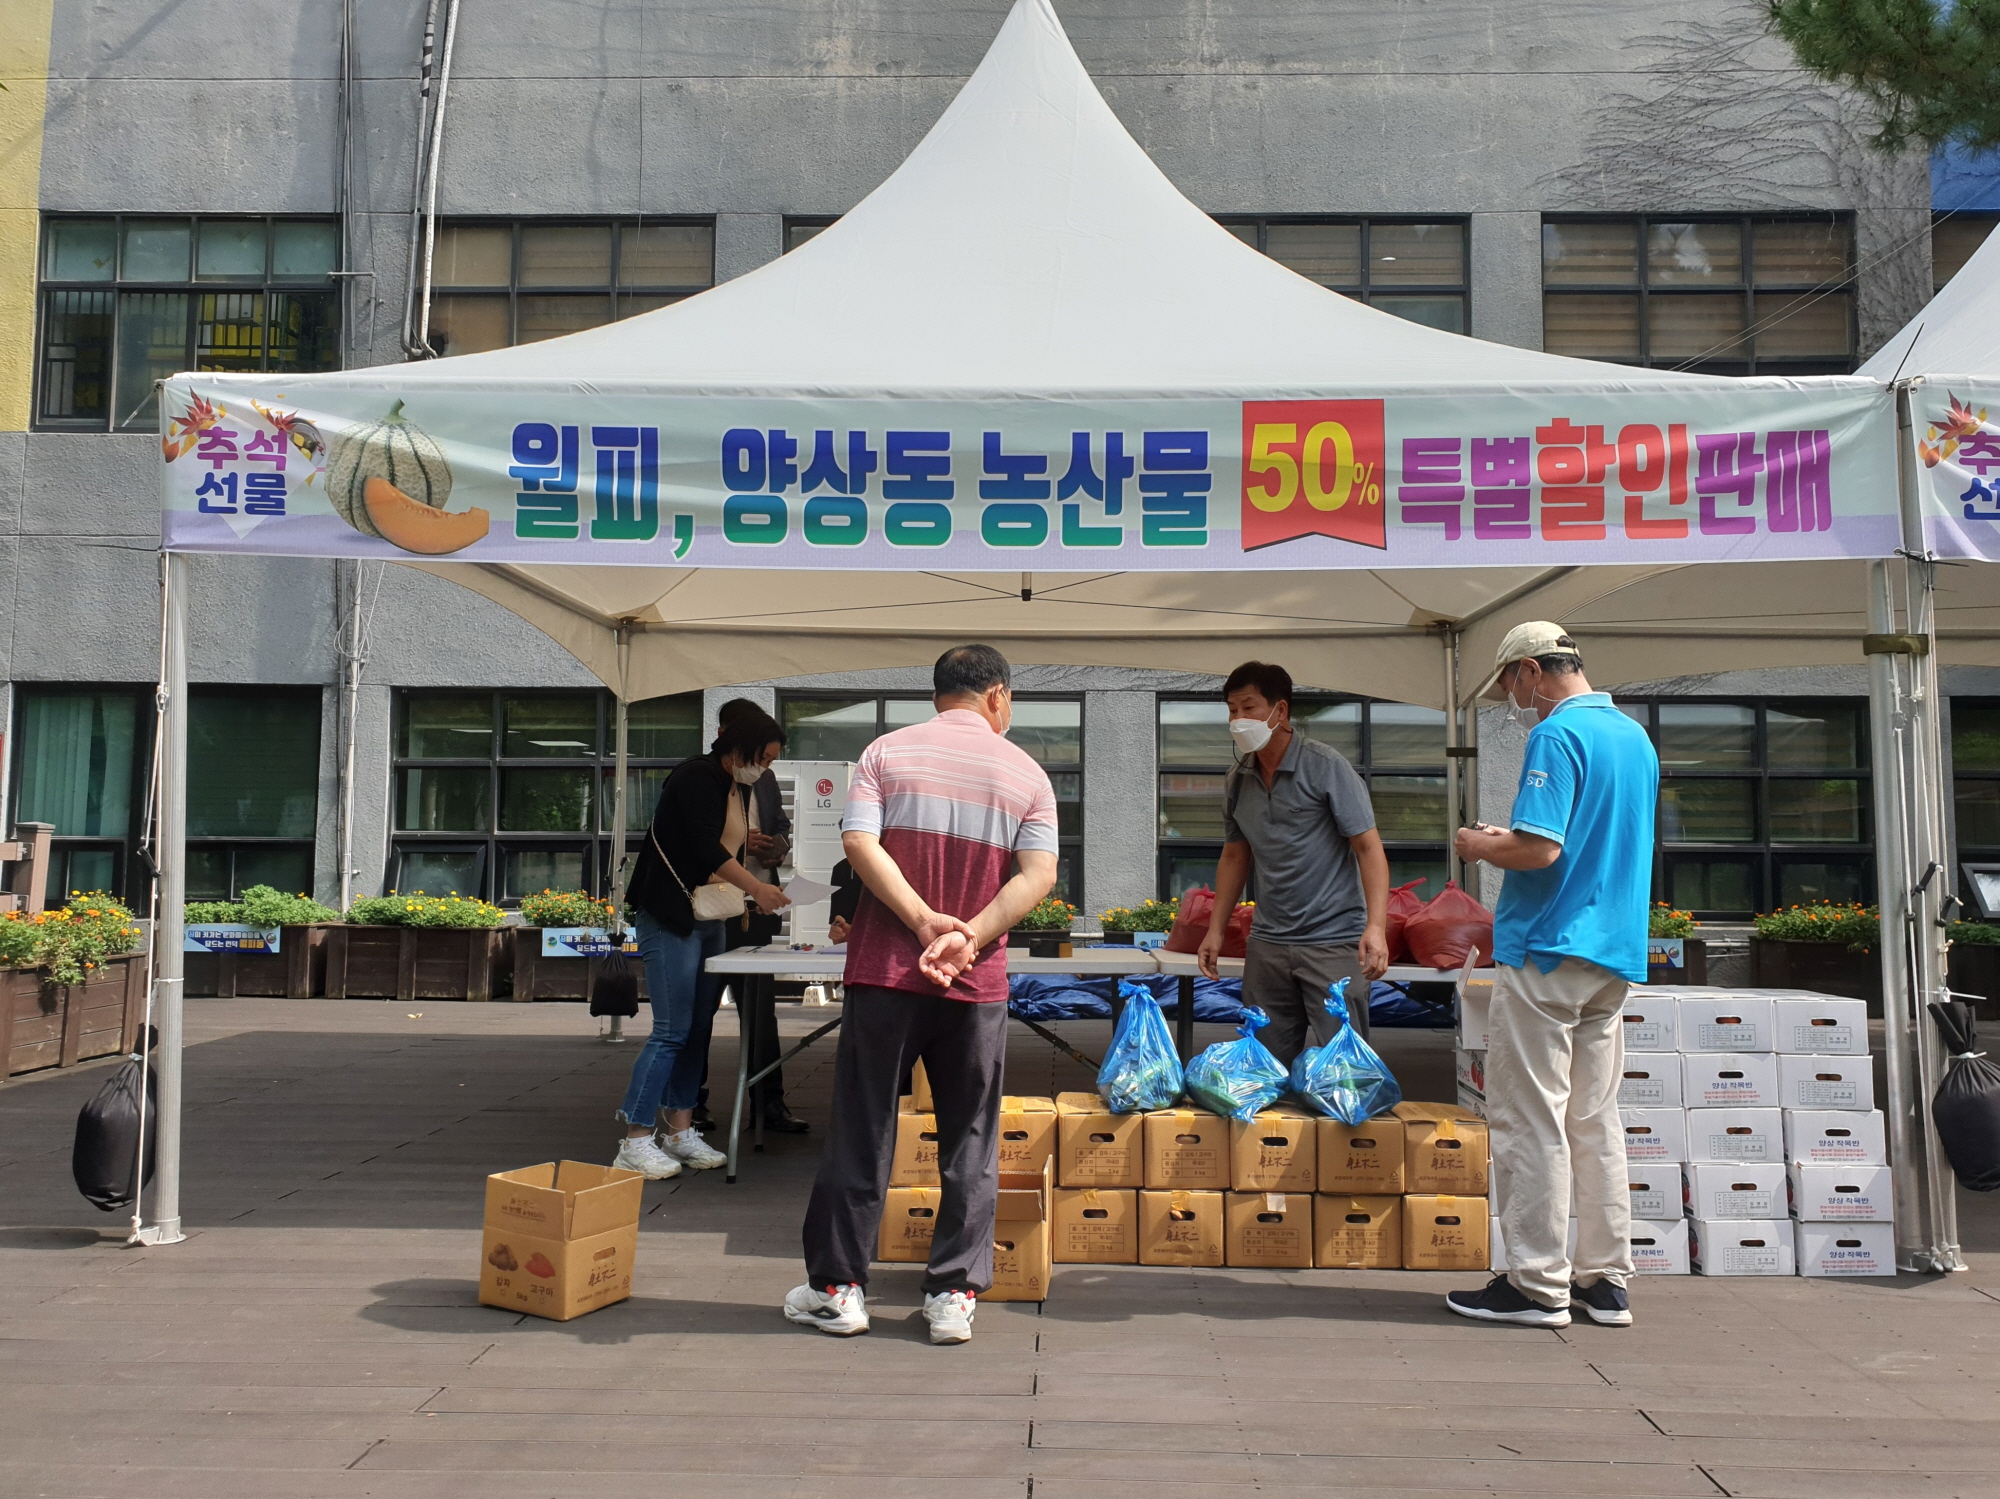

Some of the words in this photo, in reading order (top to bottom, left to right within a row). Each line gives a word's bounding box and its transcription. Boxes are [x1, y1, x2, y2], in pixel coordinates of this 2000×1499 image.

[197, 426, 289, 472] 추석
[1958, 430, 2000, 475] 추
[195, 471, 287, 516] 선물
[507, 421, 695, 562] 월피,
[720, 427, 957, 548] 양상동
[978, 428, 1213, 549] 농산물
[1246, 421, 1380, 513] 50%
[1959, 477, 2000, 520] 선
[817, 799, 831, 808] LG
[915, 1150, 939, 1164] 身土不
[496, 1276, 511, 1288] 감자
[530, 1284, 554, 1298] 고구마
